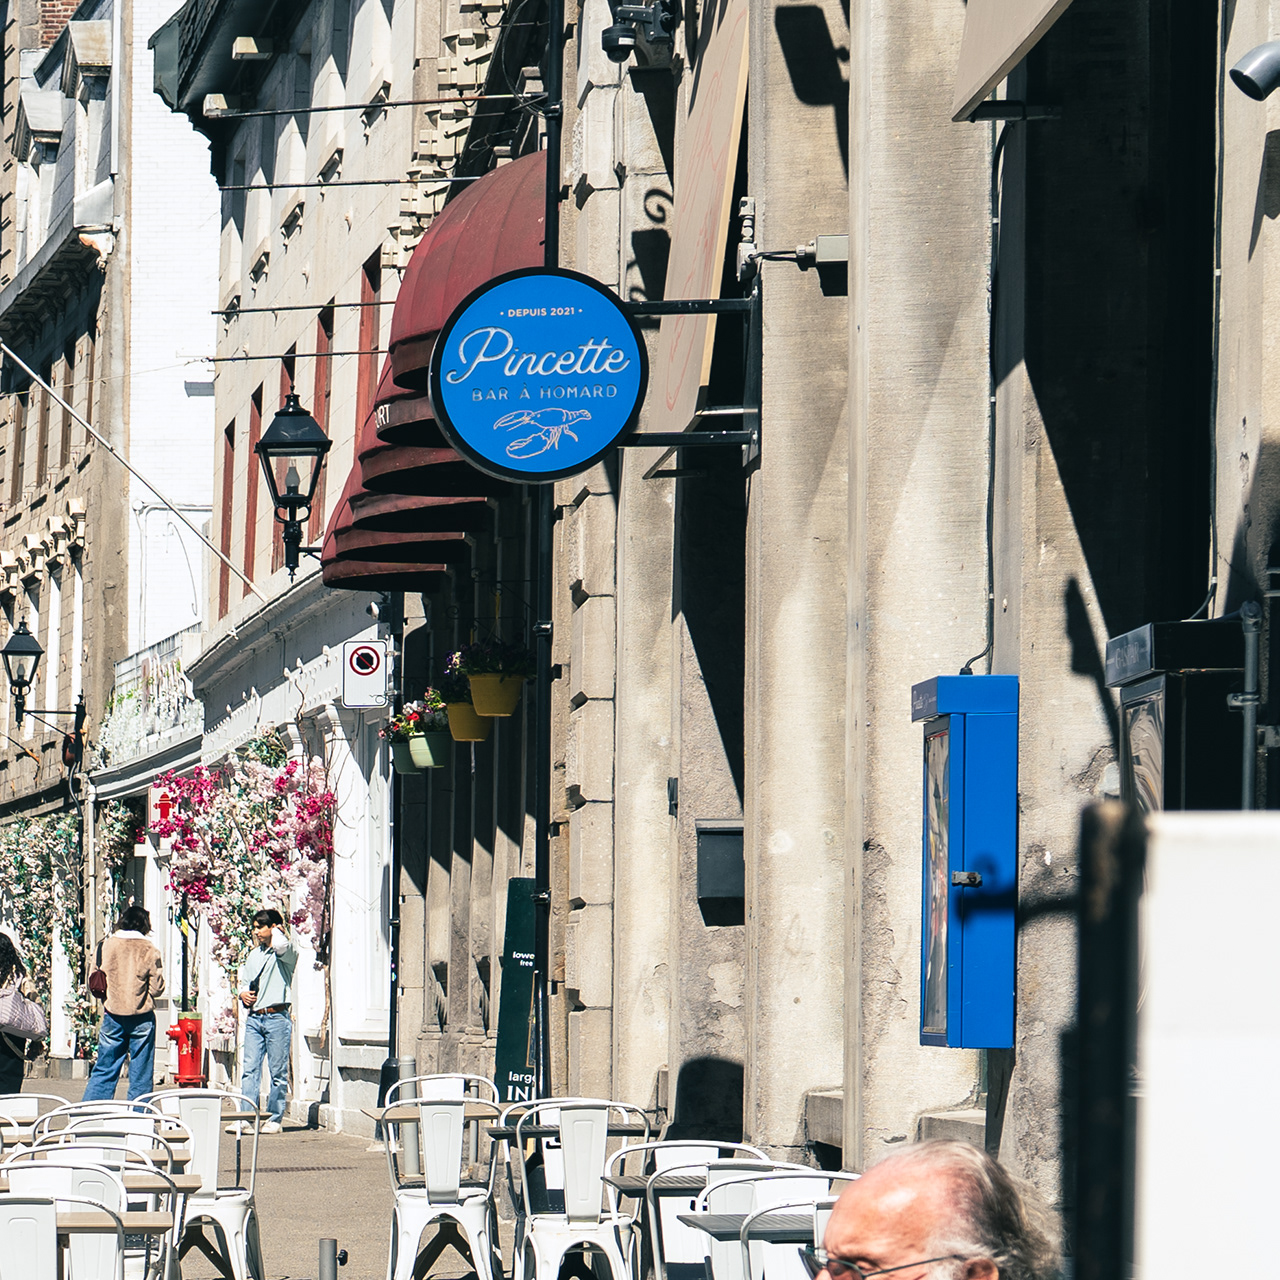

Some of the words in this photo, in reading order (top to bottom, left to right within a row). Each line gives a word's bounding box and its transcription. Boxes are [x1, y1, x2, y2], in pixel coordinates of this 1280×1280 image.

[508, 308, 547, 317] DEPUIS
[550, 307, 575, 316] 2021
[446, 326, 631, 384] Pincette
[472, 387, 509, 401] BAR
[519, 382, 531, 399] À
[540, 384, 618, 399] HOMARD
